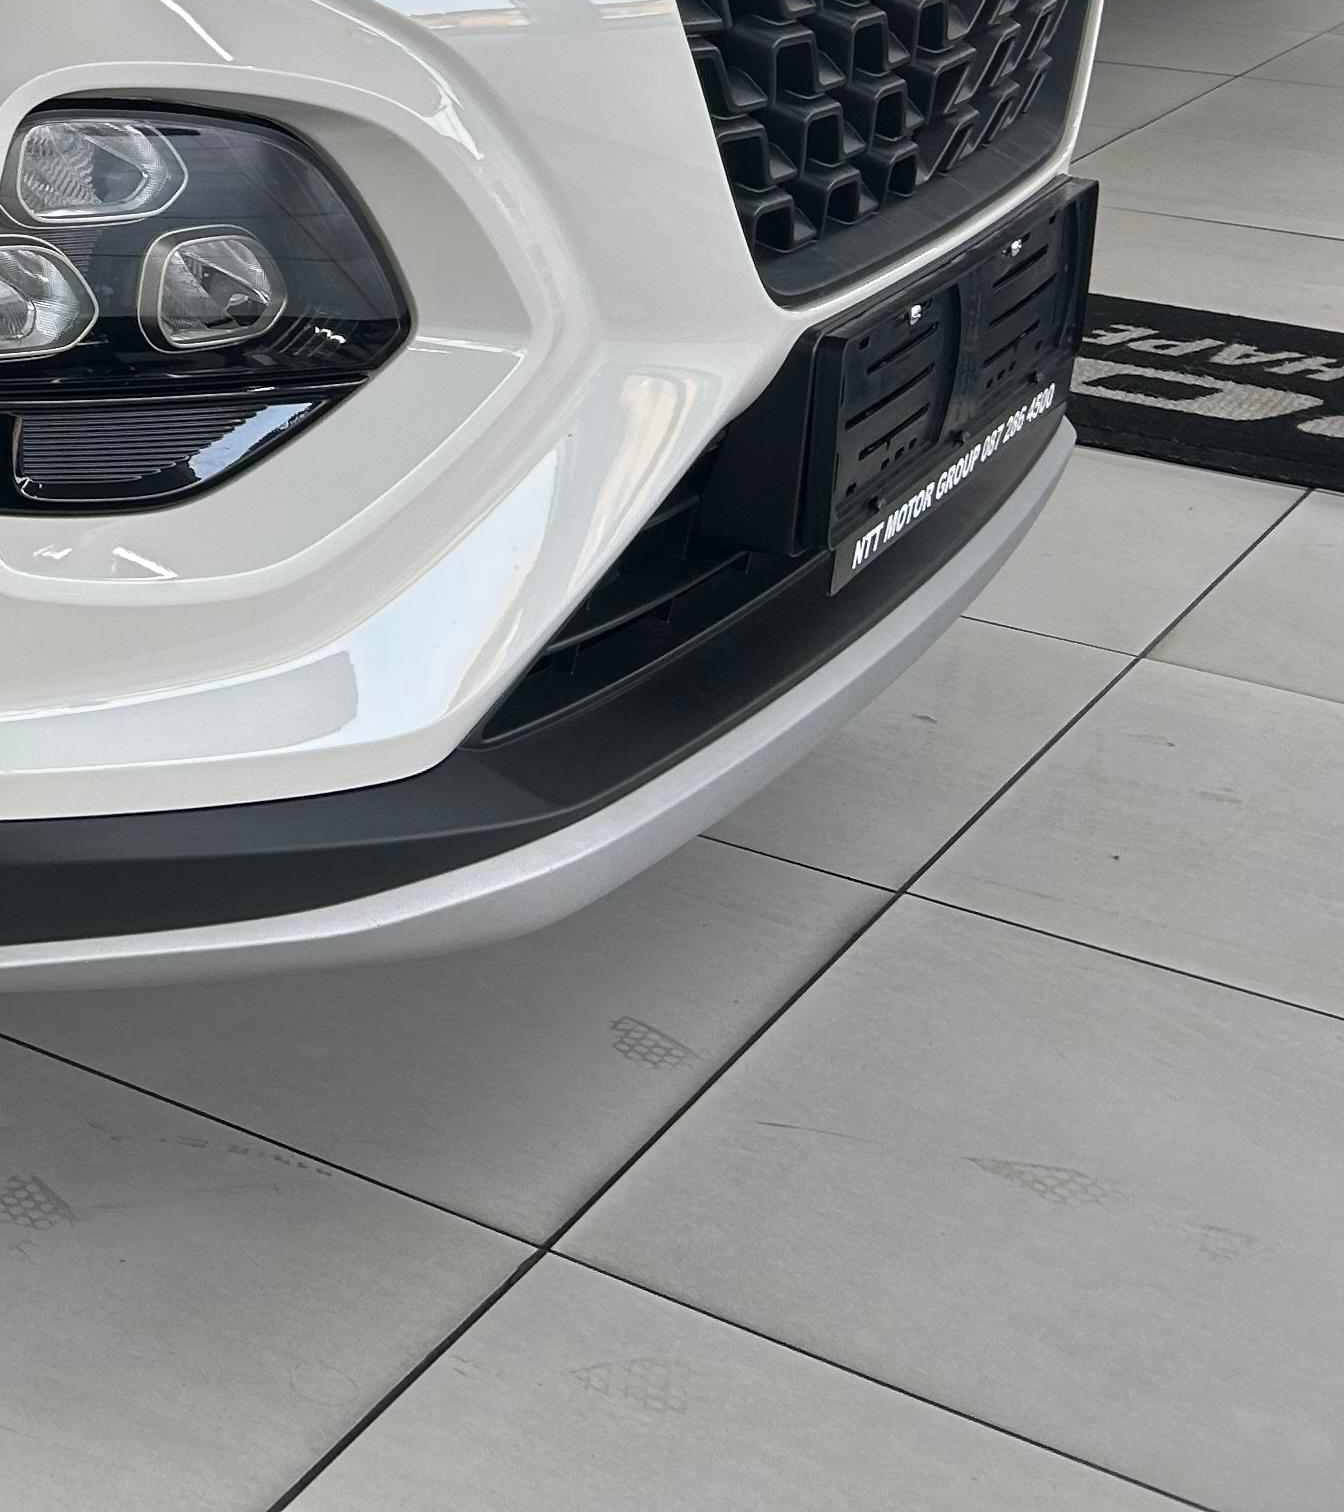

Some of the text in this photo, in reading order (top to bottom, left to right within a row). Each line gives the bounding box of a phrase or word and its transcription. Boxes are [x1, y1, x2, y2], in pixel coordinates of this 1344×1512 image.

[852, 382, 1056, 569] NTT MOTOR GROUP 087 286 4500
